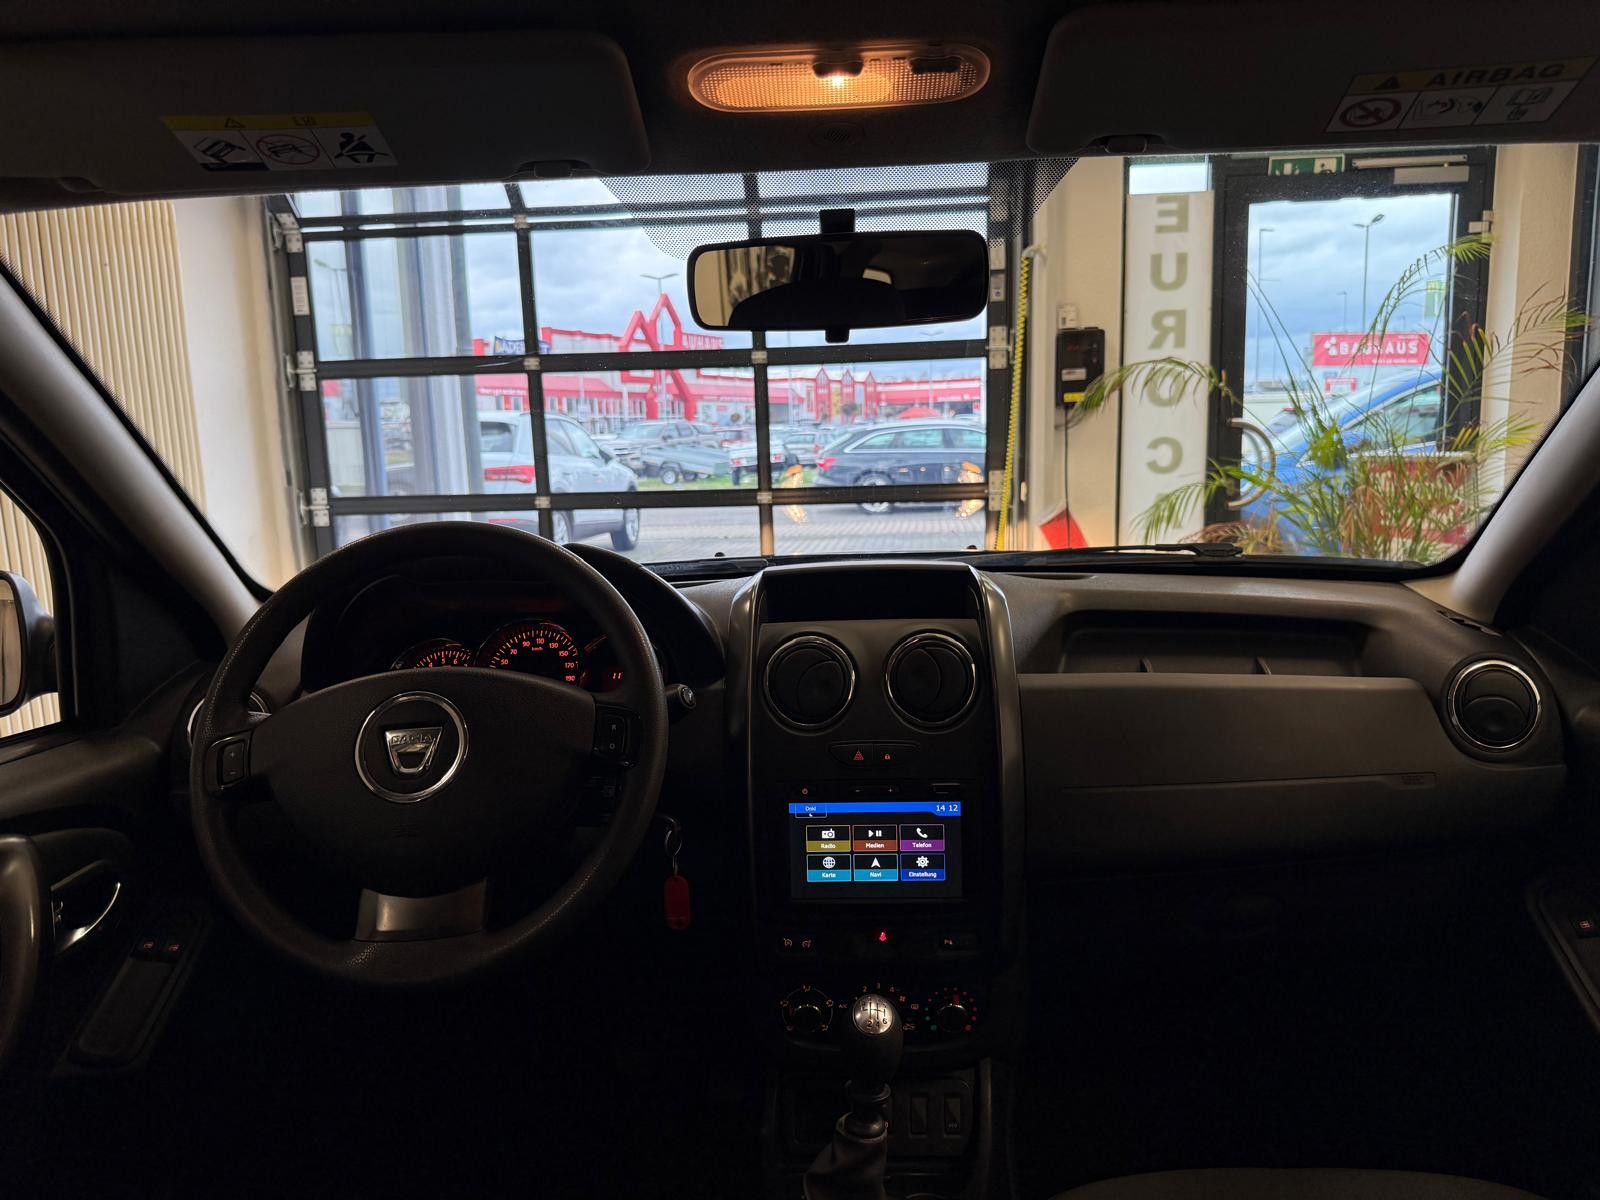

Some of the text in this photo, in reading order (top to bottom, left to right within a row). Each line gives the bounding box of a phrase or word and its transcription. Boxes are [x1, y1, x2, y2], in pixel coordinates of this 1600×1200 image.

[1424, 64, 1565, 89] AIRBAG
[500, 658, 509, 666] 50
[936, 804, 959, 812] 14 12
[908, 871, 938, 879] Einstellung
